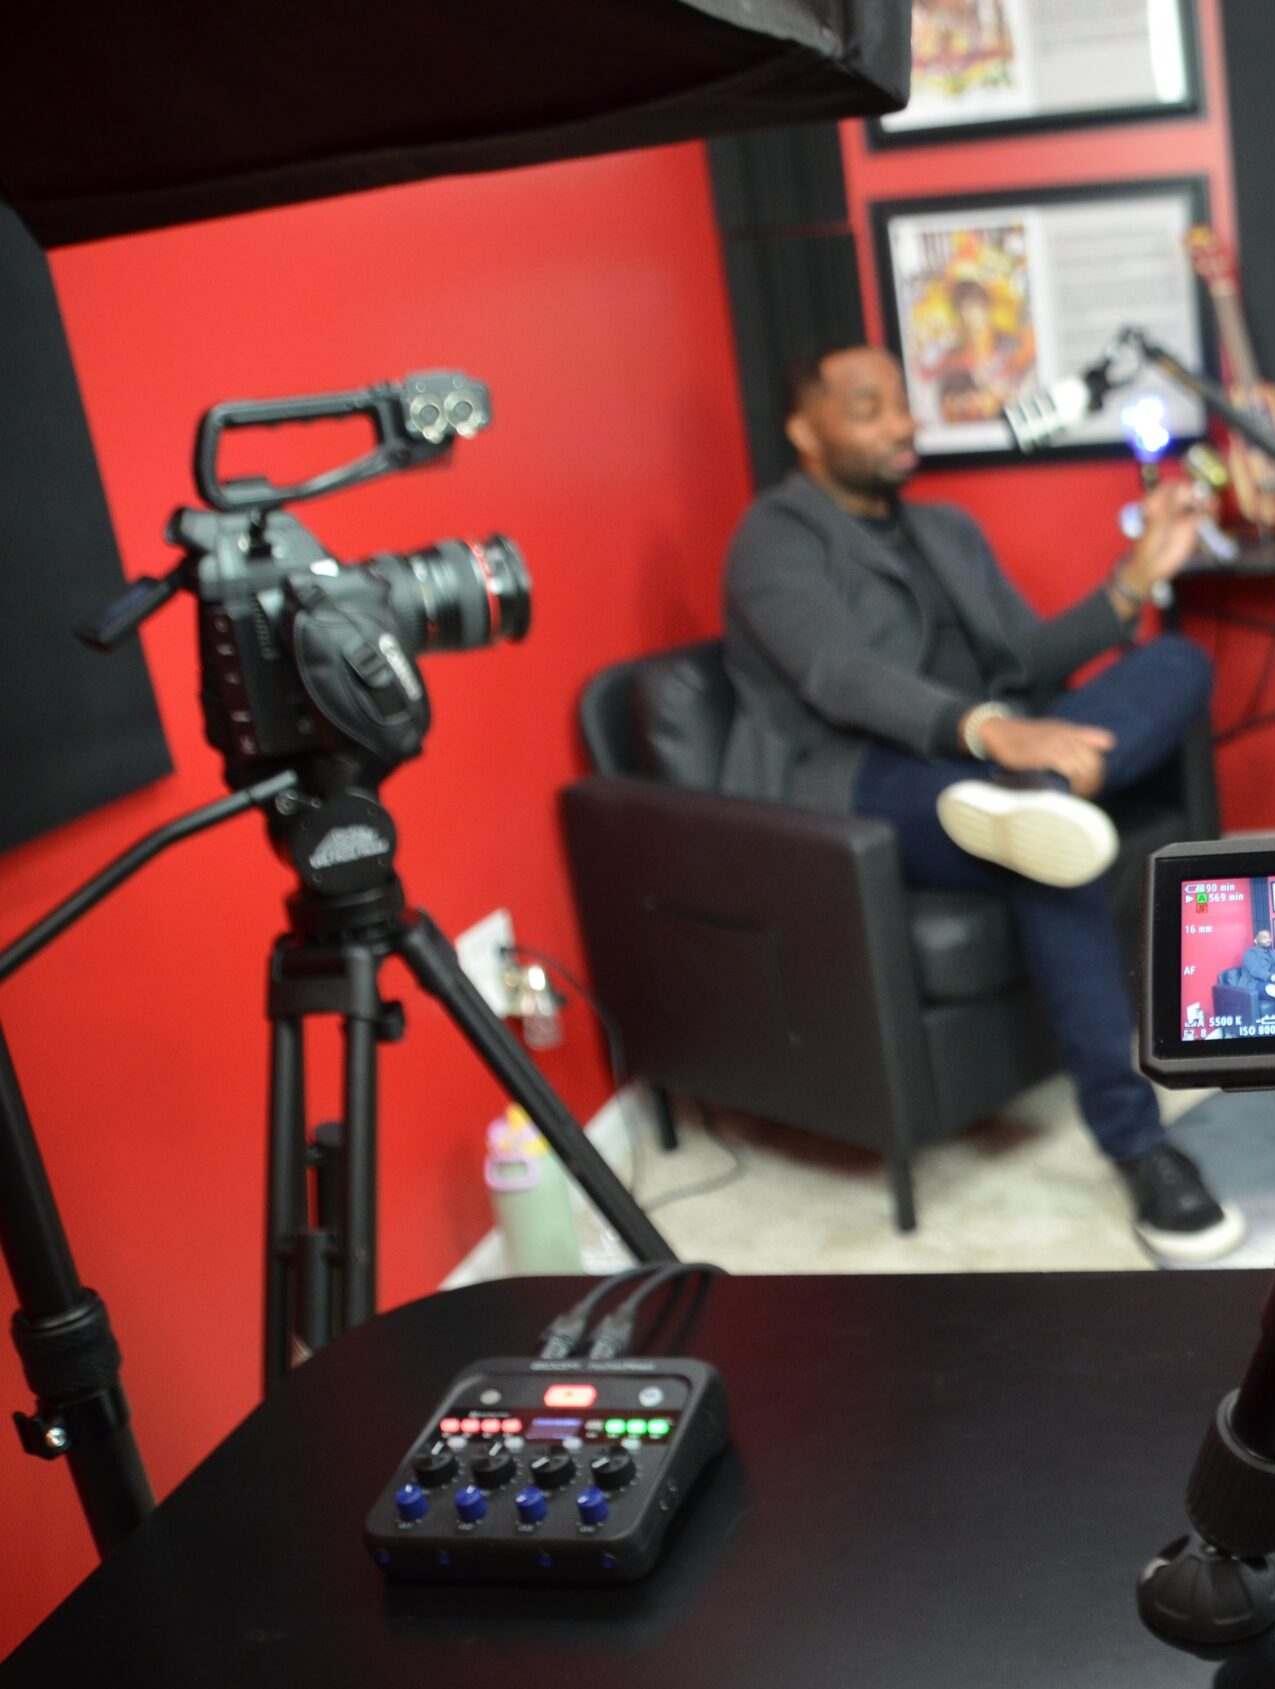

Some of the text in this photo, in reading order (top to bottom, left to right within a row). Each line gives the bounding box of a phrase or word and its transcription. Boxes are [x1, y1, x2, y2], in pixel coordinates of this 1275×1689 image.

[1209, 893, 1226, 902] 569
[1229, 893, 1244, 901] min
[1184, 967, 1196, 975] AF
[1209, 1017, 1233, 1026] 5500
[1235, 1016, 1242, 1025] K
[1240, 1025, 1275, 1036] ISO 800
